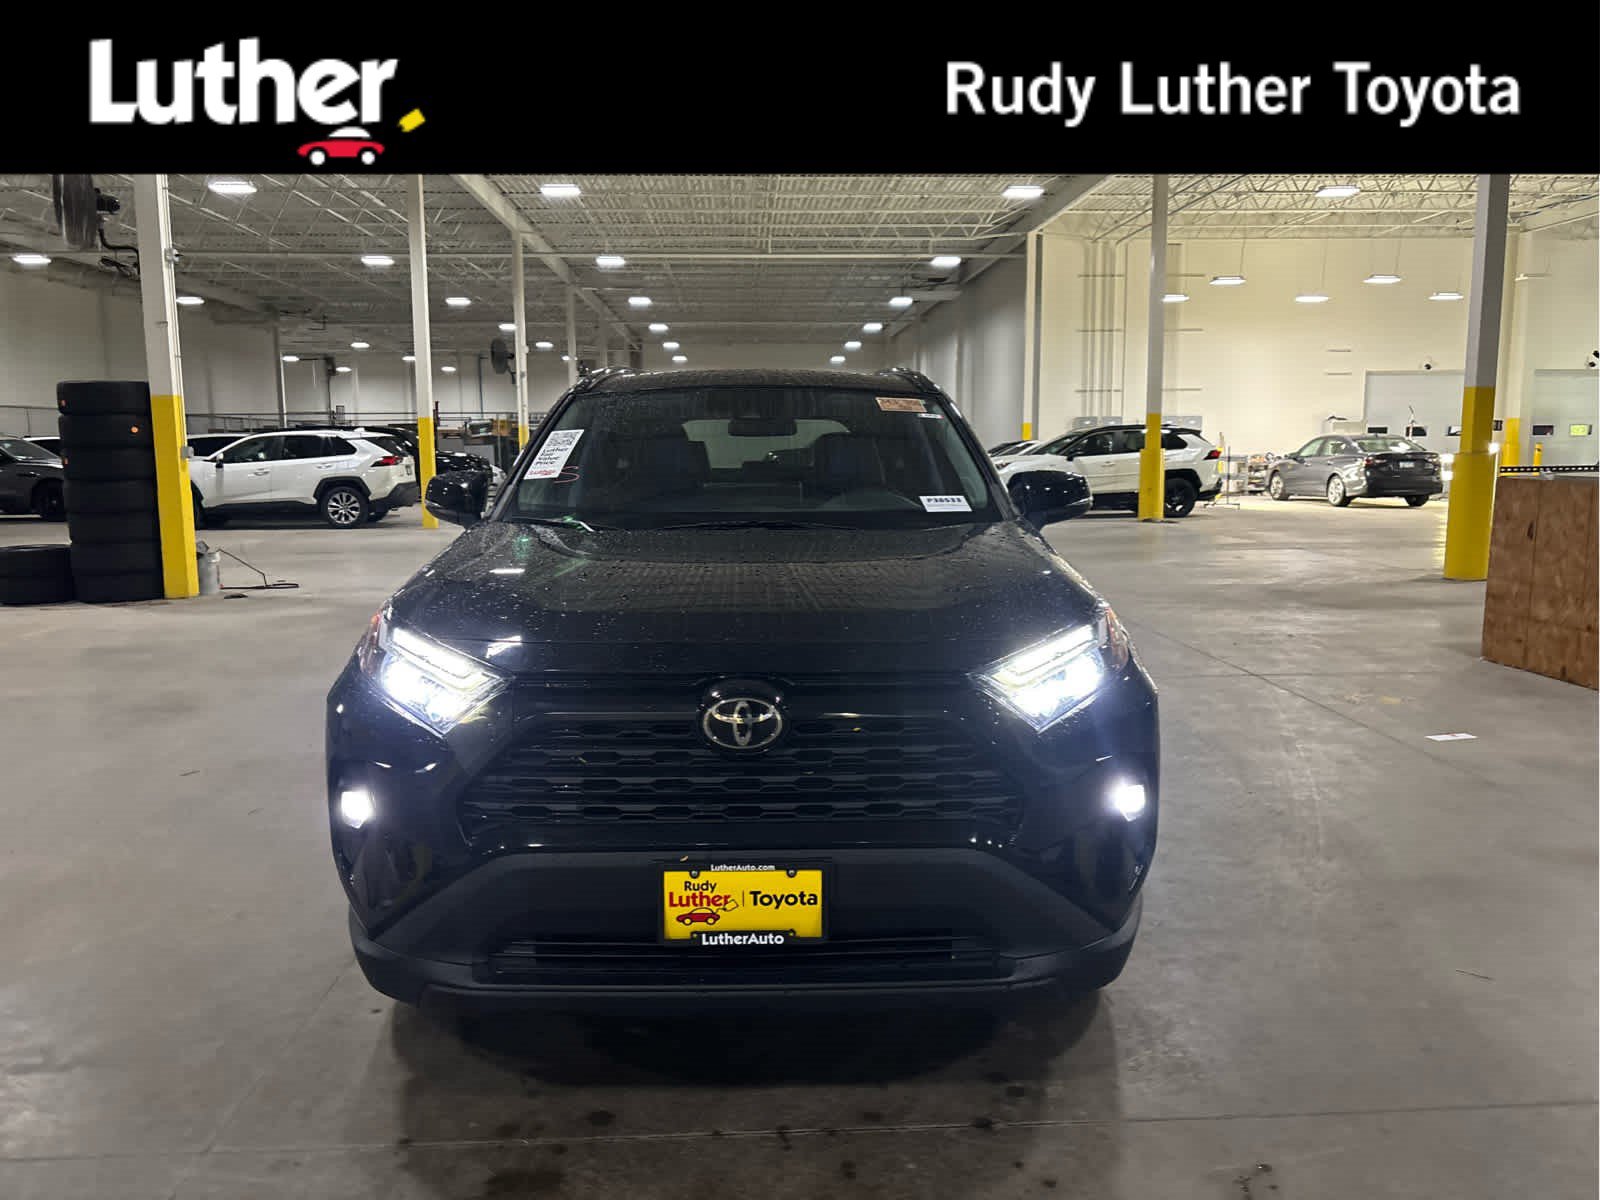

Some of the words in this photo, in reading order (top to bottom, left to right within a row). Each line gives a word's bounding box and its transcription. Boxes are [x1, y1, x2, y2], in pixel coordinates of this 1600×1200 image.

[710, 864, 776, 872] LutherAuto.com
[684, 881, 717, 893] Rudy
[669, 892, 732, 908] Luther
[749, 891, 819, 909] Toyota
[701, 933, 785, 946] LutherAuto
